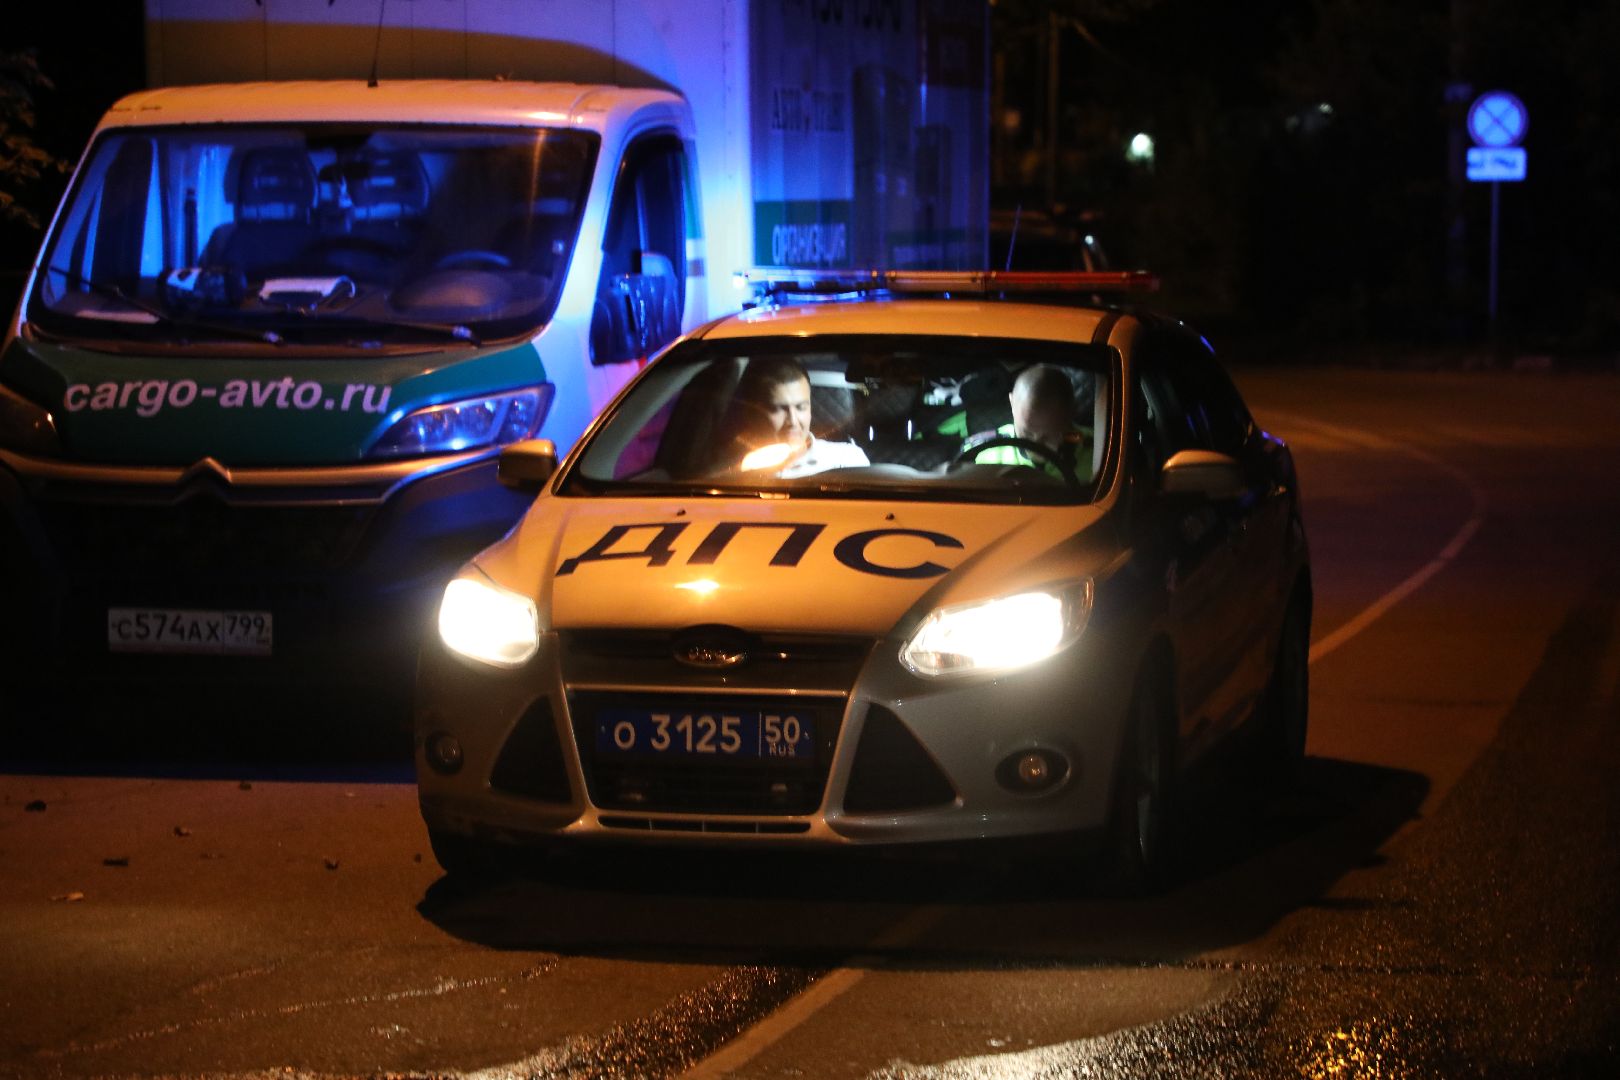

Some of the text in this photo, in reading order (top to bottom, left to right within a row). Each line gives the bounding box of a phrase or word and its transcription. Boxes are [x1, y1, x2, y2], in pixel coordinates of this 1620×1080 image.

[63, 376, 392, 418] cargo-avto.ru
[554, 520, 966, 580] ДПС
[649, 712, 743, 754] 3125
[764, 714, 801, 746] 50
